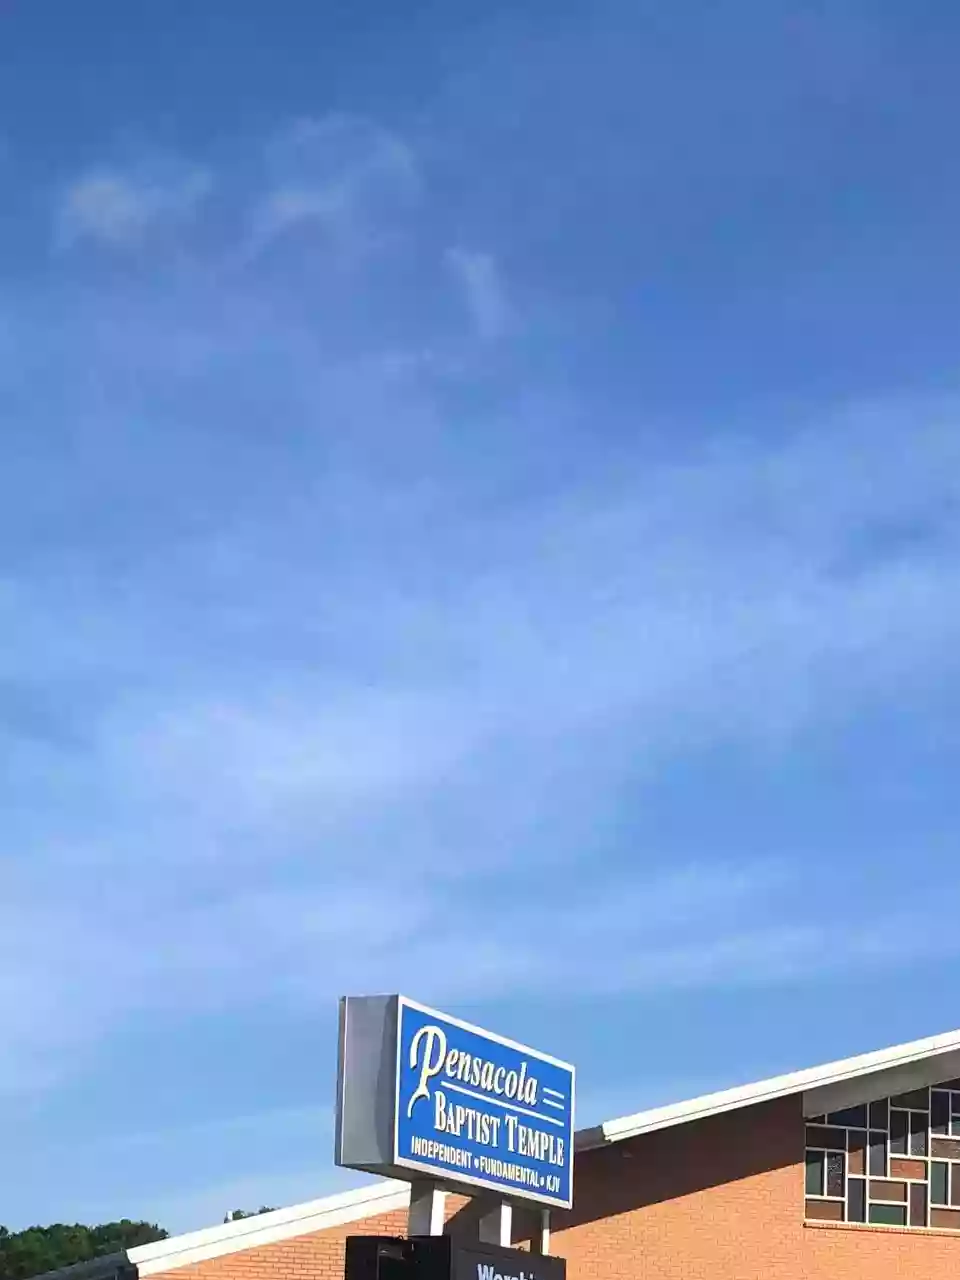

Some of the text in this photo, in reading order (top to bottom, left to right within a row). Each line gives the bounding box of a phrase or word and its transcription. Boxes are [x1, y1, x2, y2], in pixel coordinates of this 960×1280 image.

[407, 1025, 537, 1118] Pensacola
[411, 1136, 560, 1193] INDEPENDENT FUNDAMENTAL KJV
[434, 1091, 564, 1167] BAPTIST TEMPLE
